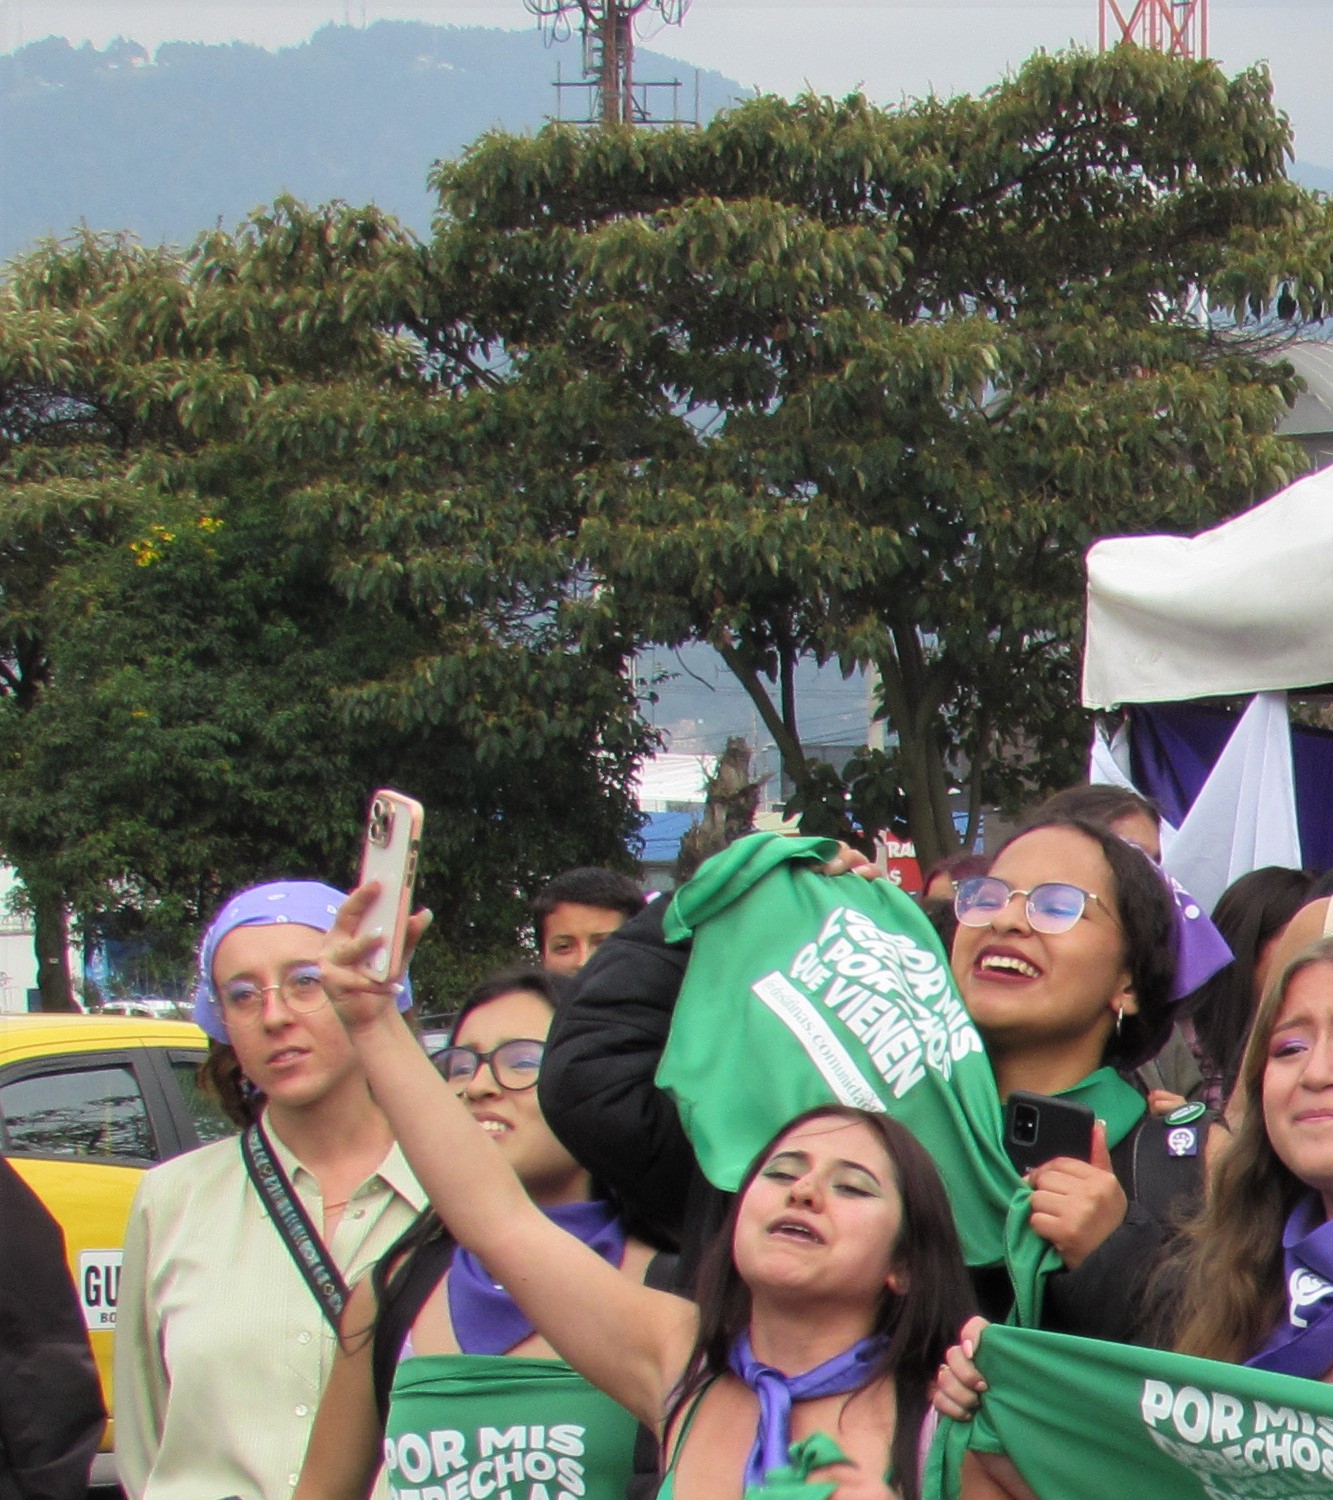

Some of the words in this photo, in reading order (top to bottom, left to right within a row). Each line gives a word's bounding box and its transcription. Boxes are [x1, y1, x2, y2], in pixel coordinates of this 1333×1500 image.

[788, 942, 833, 993] QUE
[824, 977, 926, 1099] VIENEN
[478, 1424, 586, 1458] MIS
[1141, 1378, 1244, 1445] POR
